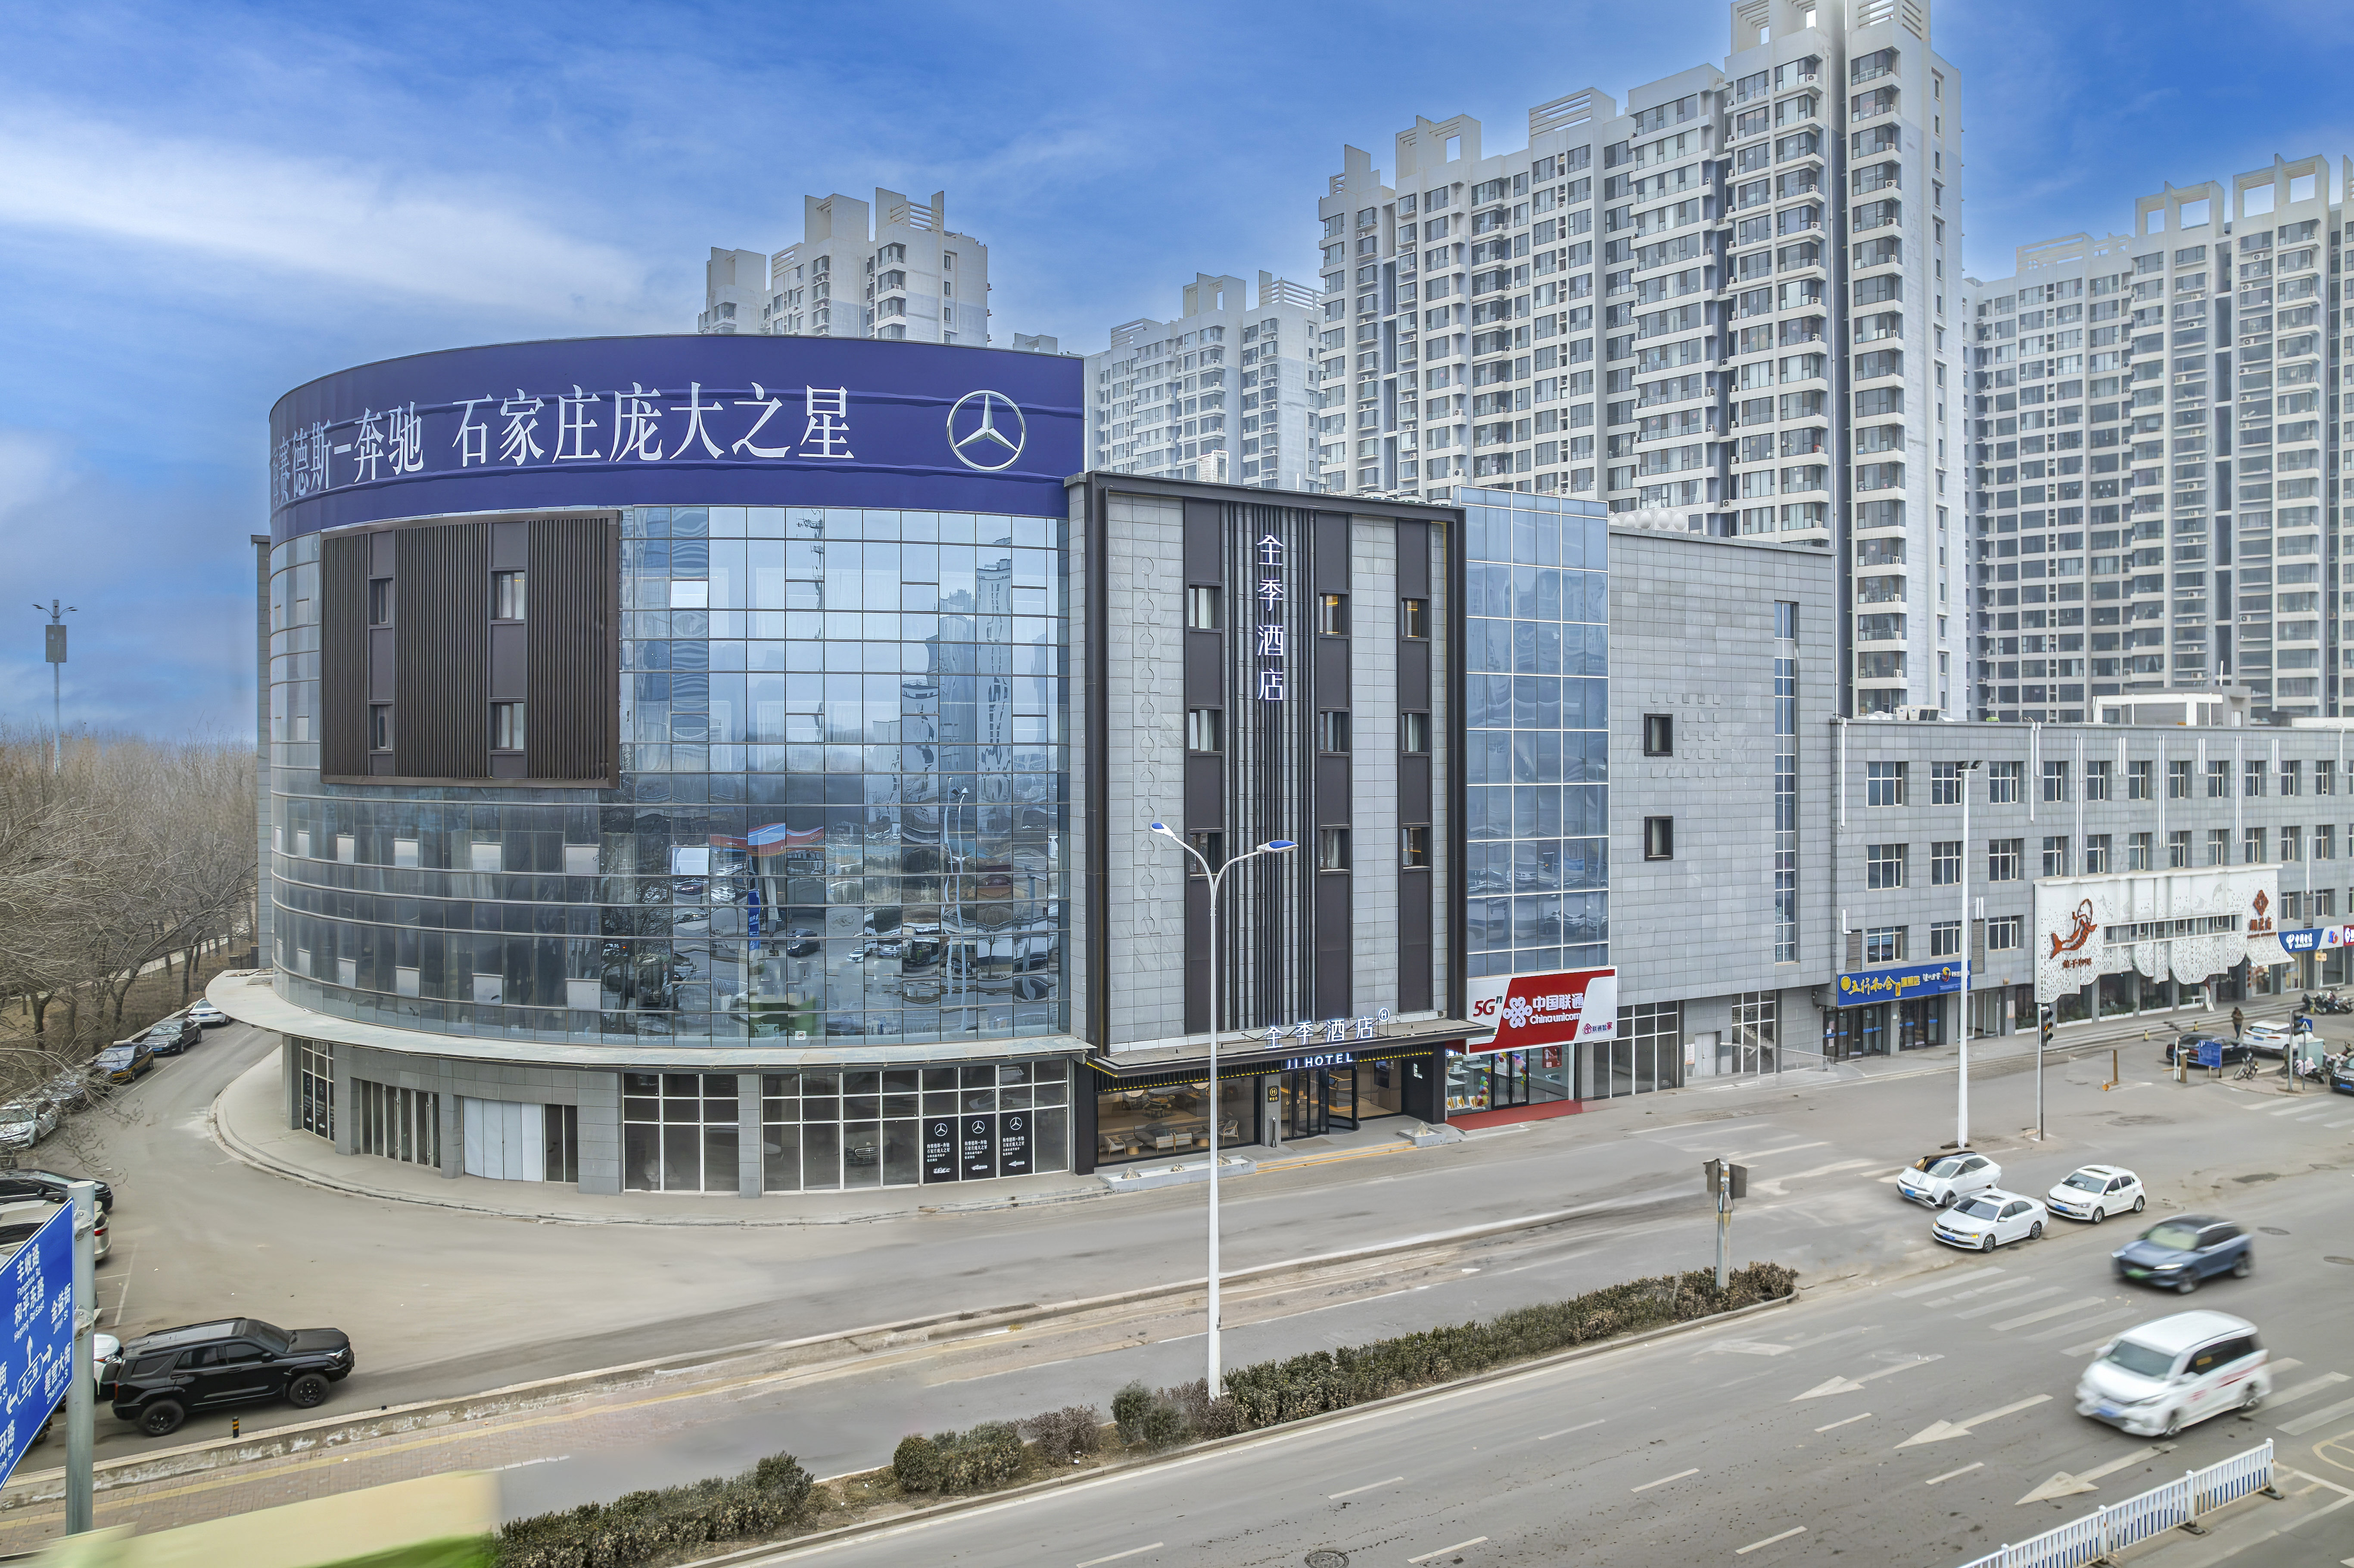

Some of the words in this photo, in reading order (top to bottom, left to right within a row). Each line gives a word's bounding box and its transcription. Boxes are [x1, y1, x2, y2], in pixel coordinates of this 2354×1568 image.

[452, 381, 854, 467] 石家庄庞大之星
[1256, 534, 1284, 700] 全季酒店
[1532, 993, 1584, 1012] 中国联通
[1264, 1016, 1373, 1049] 全季酒店
[1305, 1052, 1353, 1068] HOTEL
[17, 1243, 40, 1284] 丰收路
[14, 1276, 44, 1327] 和平东路
